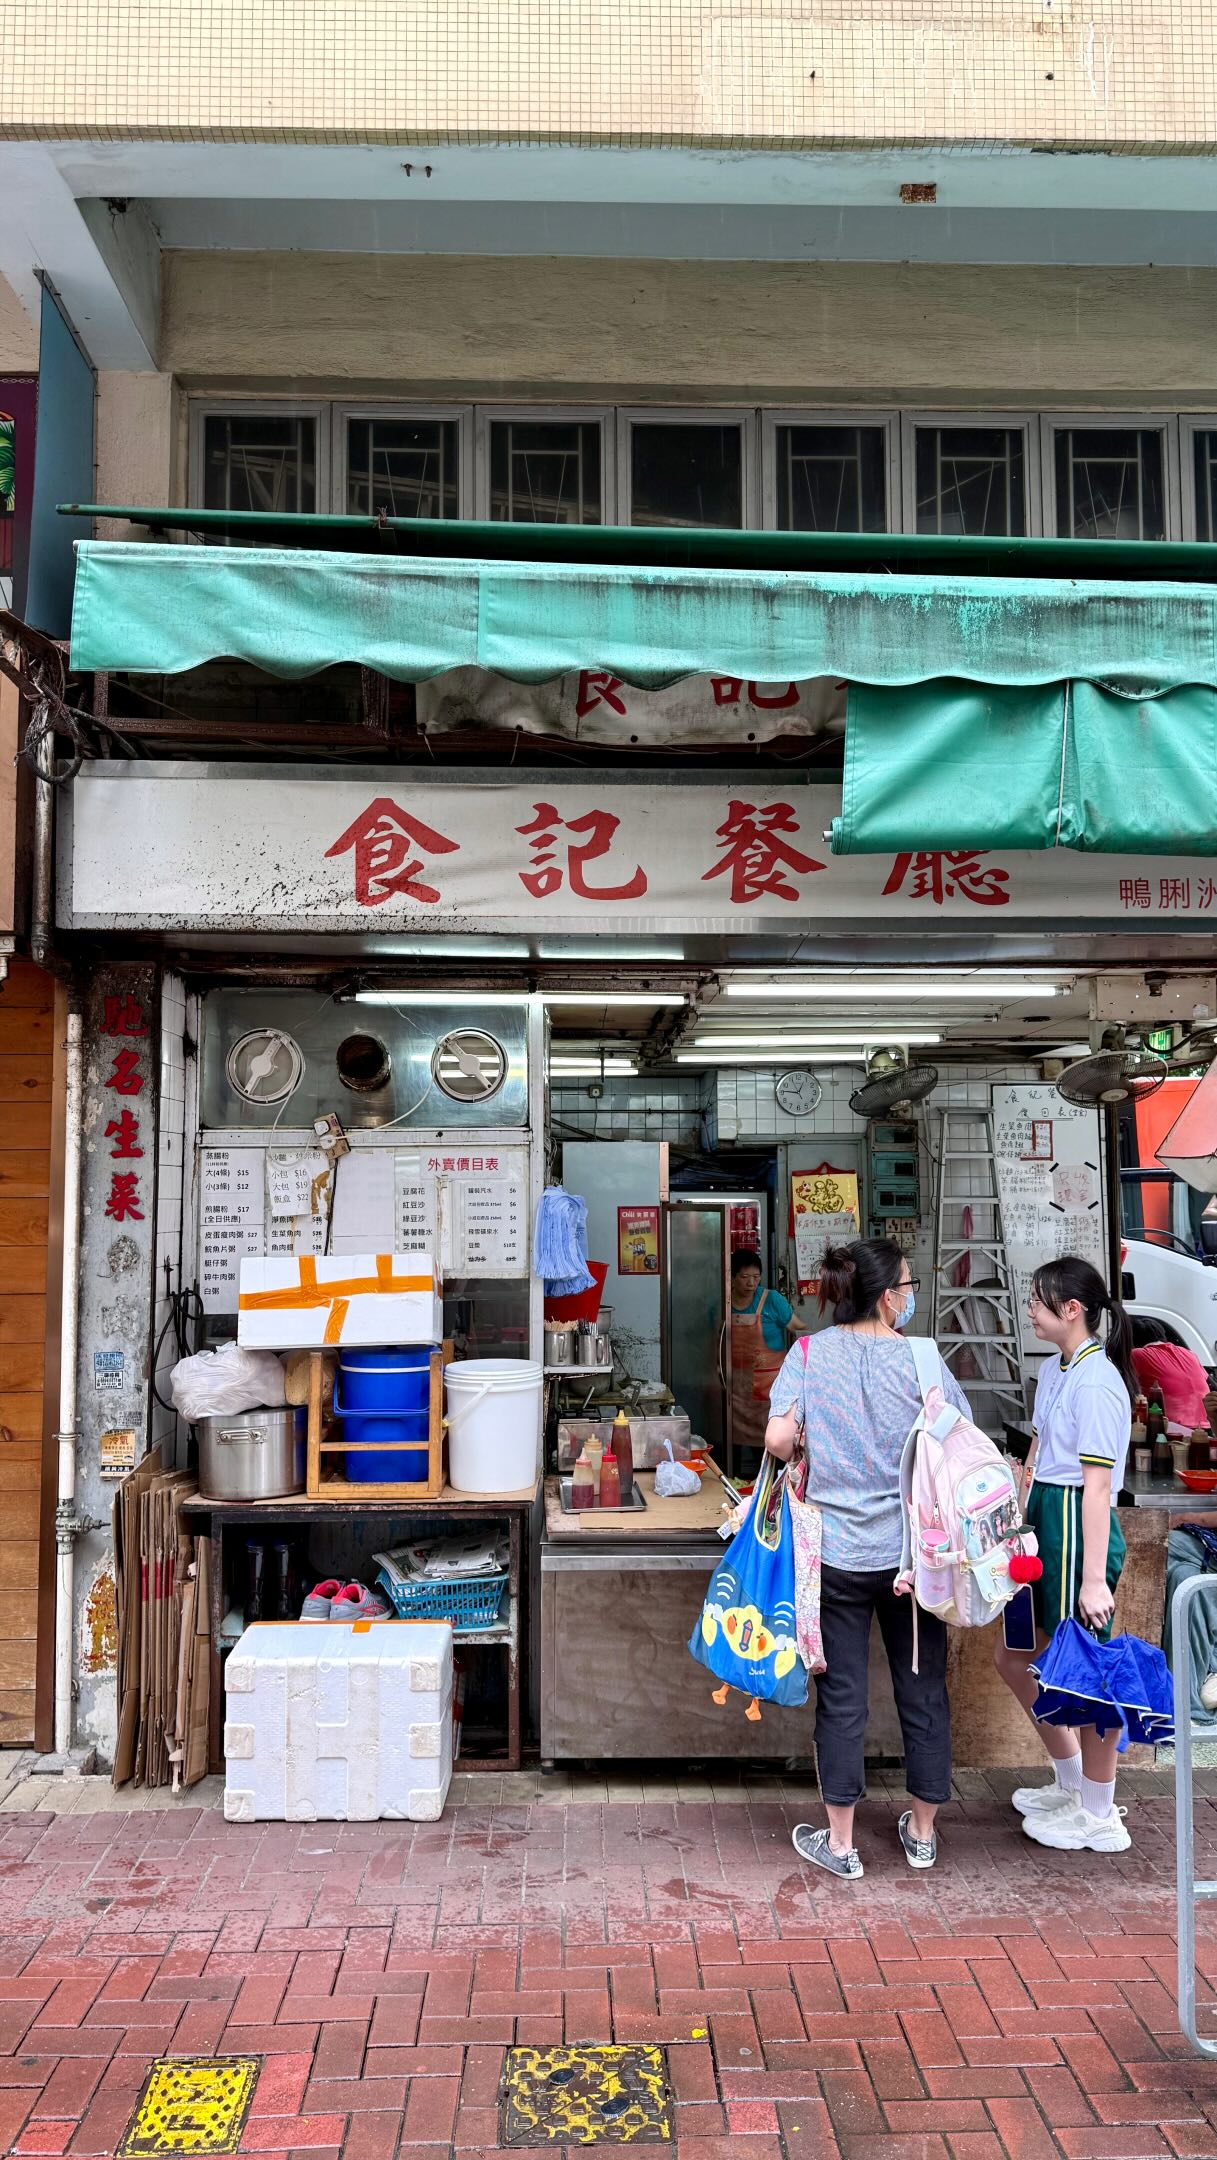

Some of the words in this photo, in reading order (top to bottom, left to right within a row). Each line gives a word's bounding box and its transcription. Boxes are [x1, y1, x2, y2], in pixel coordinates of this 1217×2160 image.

[99, 994, 147, 1221] 馳名生菜
[428, 1158, 499, 1171] 外賣價目表
[237, 1169, 249, 1177] $15
[272, 1170, 289, 1179] 小包
[272, 1183, 290, 1191] 大包
[402, 1187, 426, 1196] 豆腐花
[297, 1193, 309, 1201] $22
[402, 1201, 426, 1209] 紅豆沙
[204, 1230, 244, 1240] 皮蛋瘦肉粥
[271, 1230, 302, 1238] 生菜魚肉
[203, 1287, 220, 1295] 白粥
[109, 1435, 129, 1445] 冷氣
